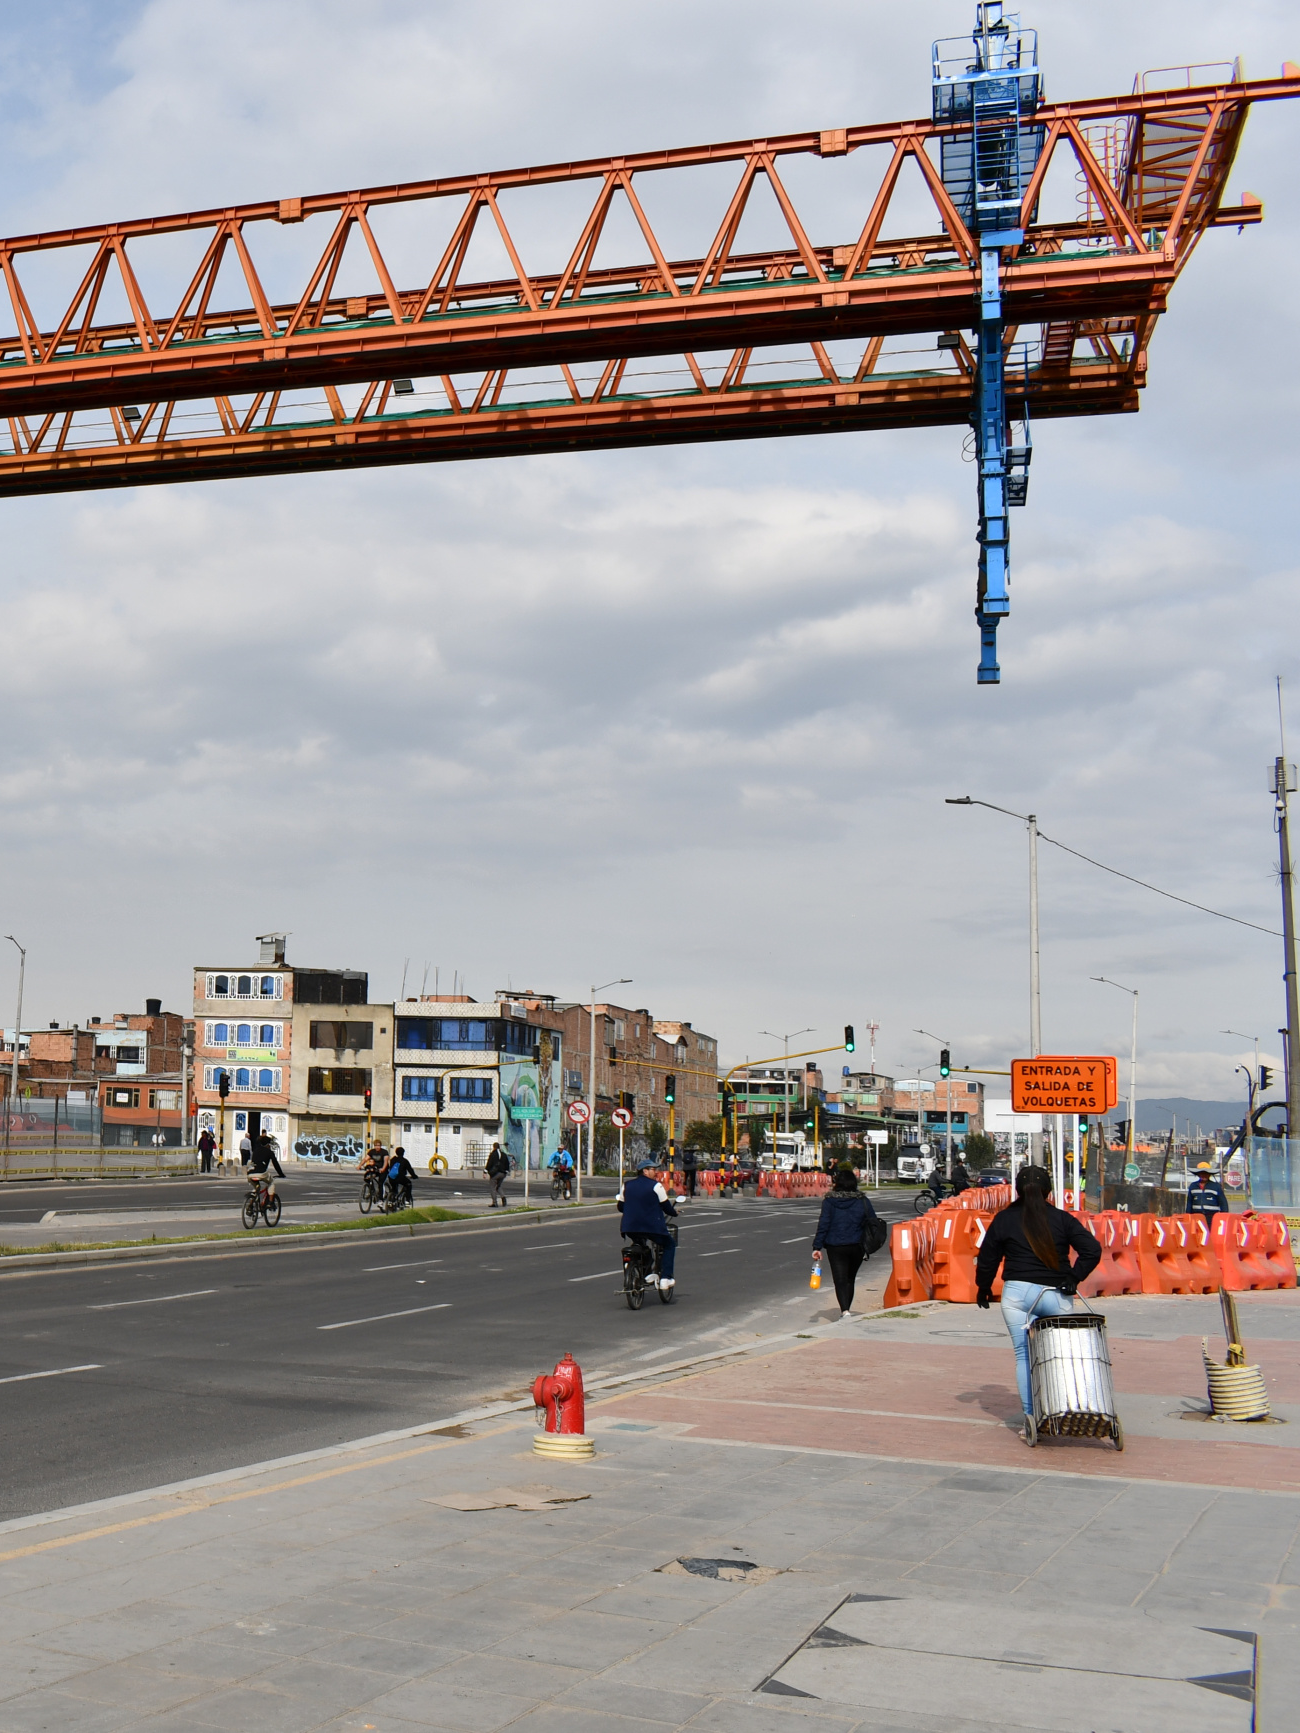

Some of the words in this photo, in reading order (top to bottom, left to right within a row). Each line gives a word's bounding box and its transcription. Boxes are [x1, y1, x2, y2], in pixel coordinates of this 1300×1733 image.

[1022, 1066, 1081, 1076] ENTRADA
[1087, 1066, 1096, 1076] Y
[1025, 1081, 1071, 1091] SALIDA
[1077, 1082, 1094, 1092] DE
[1022, 1097, 1097, 1107] VOLQUETAS
[1126, 1167, 1138, 1175] SIGA
